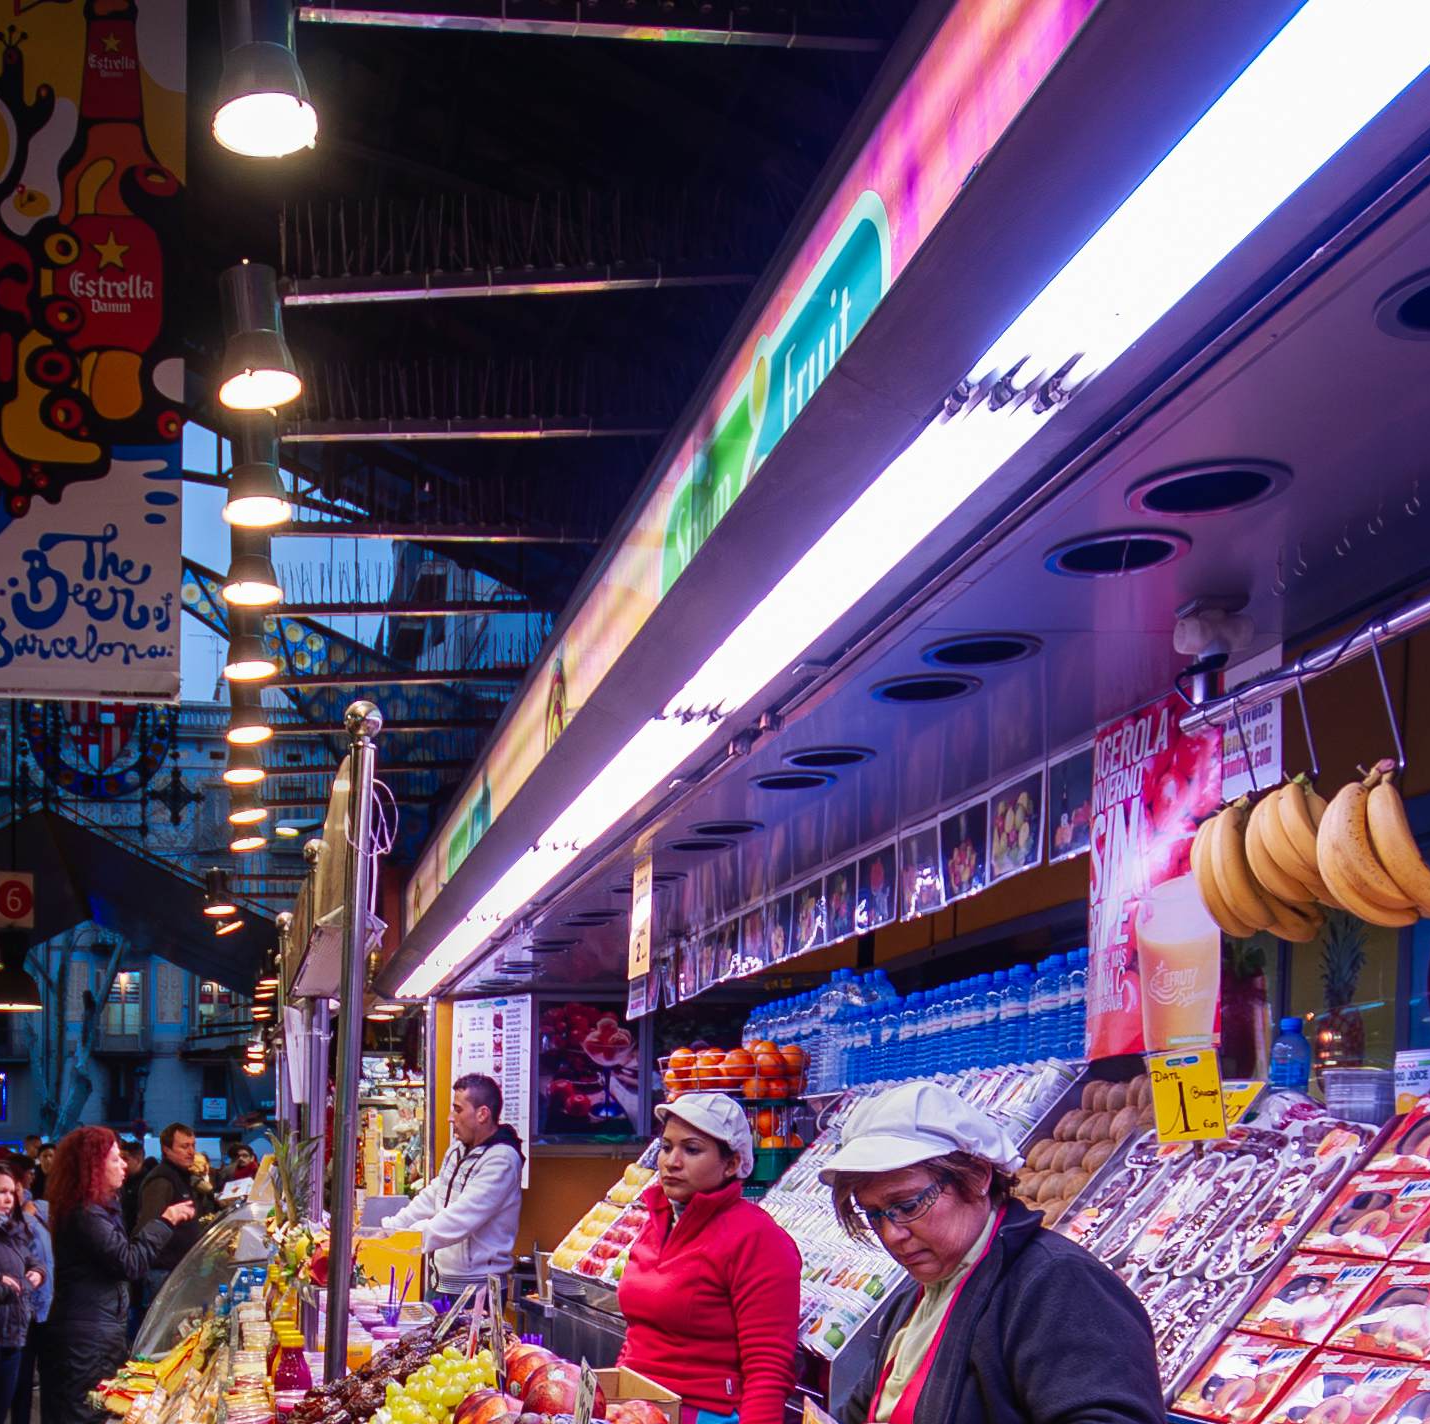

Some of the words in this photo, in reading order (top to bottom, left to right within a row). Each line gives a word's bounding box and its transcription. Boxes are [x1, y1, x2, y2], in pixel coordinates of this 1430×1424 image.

[87, 54, 137, 70] Estrella
[69, 271, 155, 300] Estrella
[91, 299, 132, 314] Damm
[39, 523, 151, 581] The
[11, 549, 150, 630] Beer
[154, 592, 172, 632] of
[6, 887, 23, 912] 6
[1161, 1080, 1199, 1136] 1
[1335, 1263, 1386, 1283] WABU
[1265, 1348, 1309, 1365] WABU
[1365, 1366, 1412, 1384] WABU
